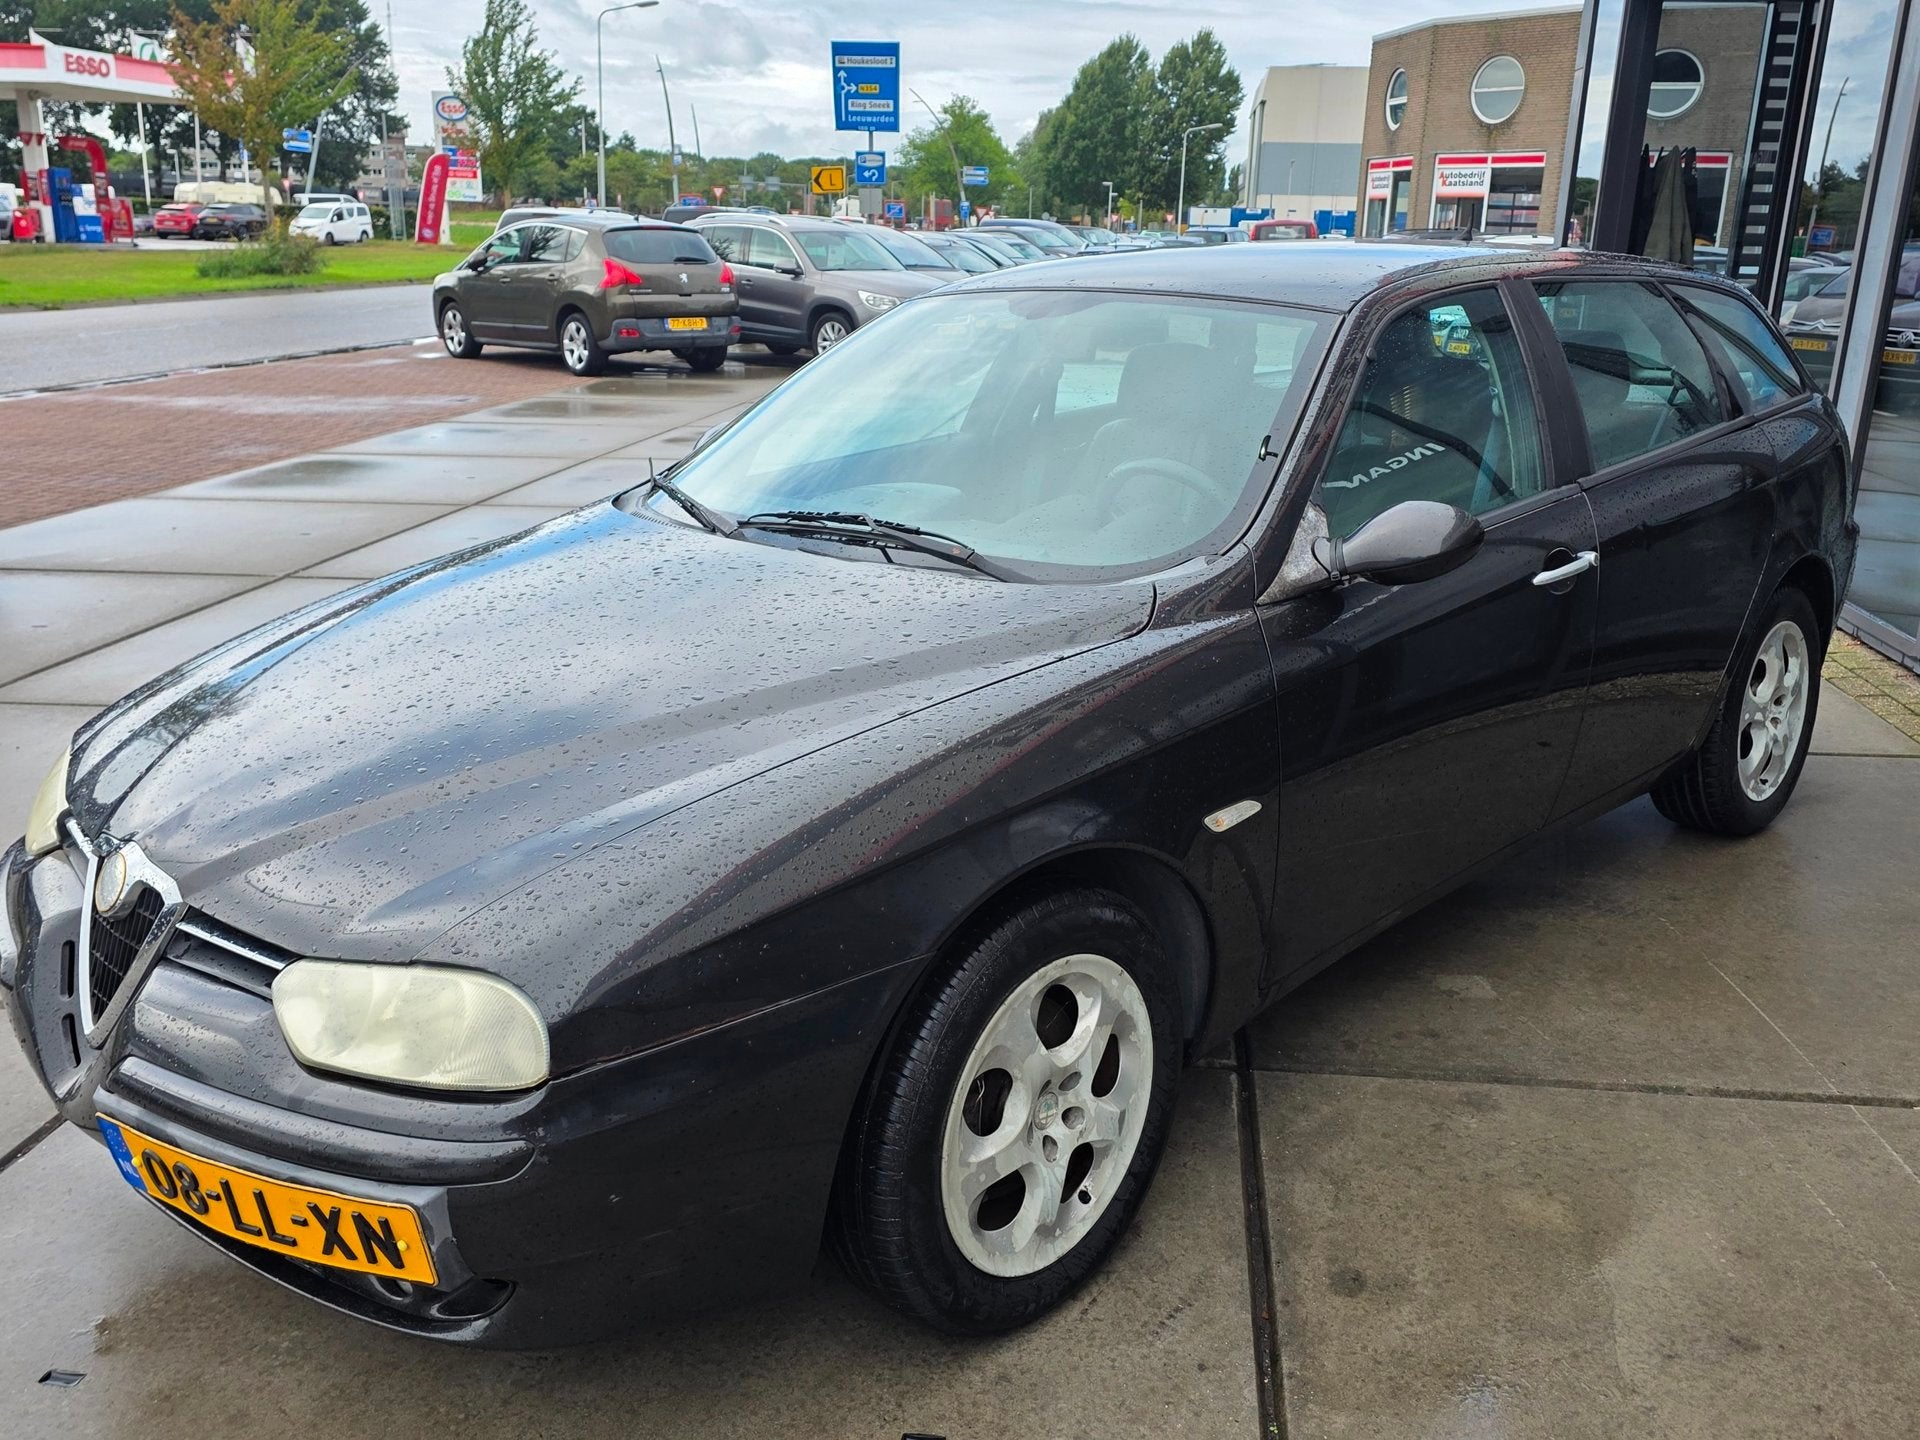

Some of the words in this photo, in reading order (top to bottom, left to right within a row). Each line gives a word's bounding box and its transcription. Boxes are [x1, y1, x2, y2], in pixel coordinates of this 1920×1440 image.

[64, 53, 110, 77] ESSO
[846, 57, 888, 65] Houkesloot
[441, 102, 465, 113] Esso
[850, 101, 867, 110] Ring
[868, 101, 891, 109] Sneek
[848, 115, 895, 123] Leeuwarden
[829, 173, 836, 187] L
[1439, 171, 1486, 181] Autobedrijf
[1441, 179, 1484, 187] Kaatsland
[118, 1157, 141, 1180] NL
[141, 1147, 405, 1270] 08-LL-XN
